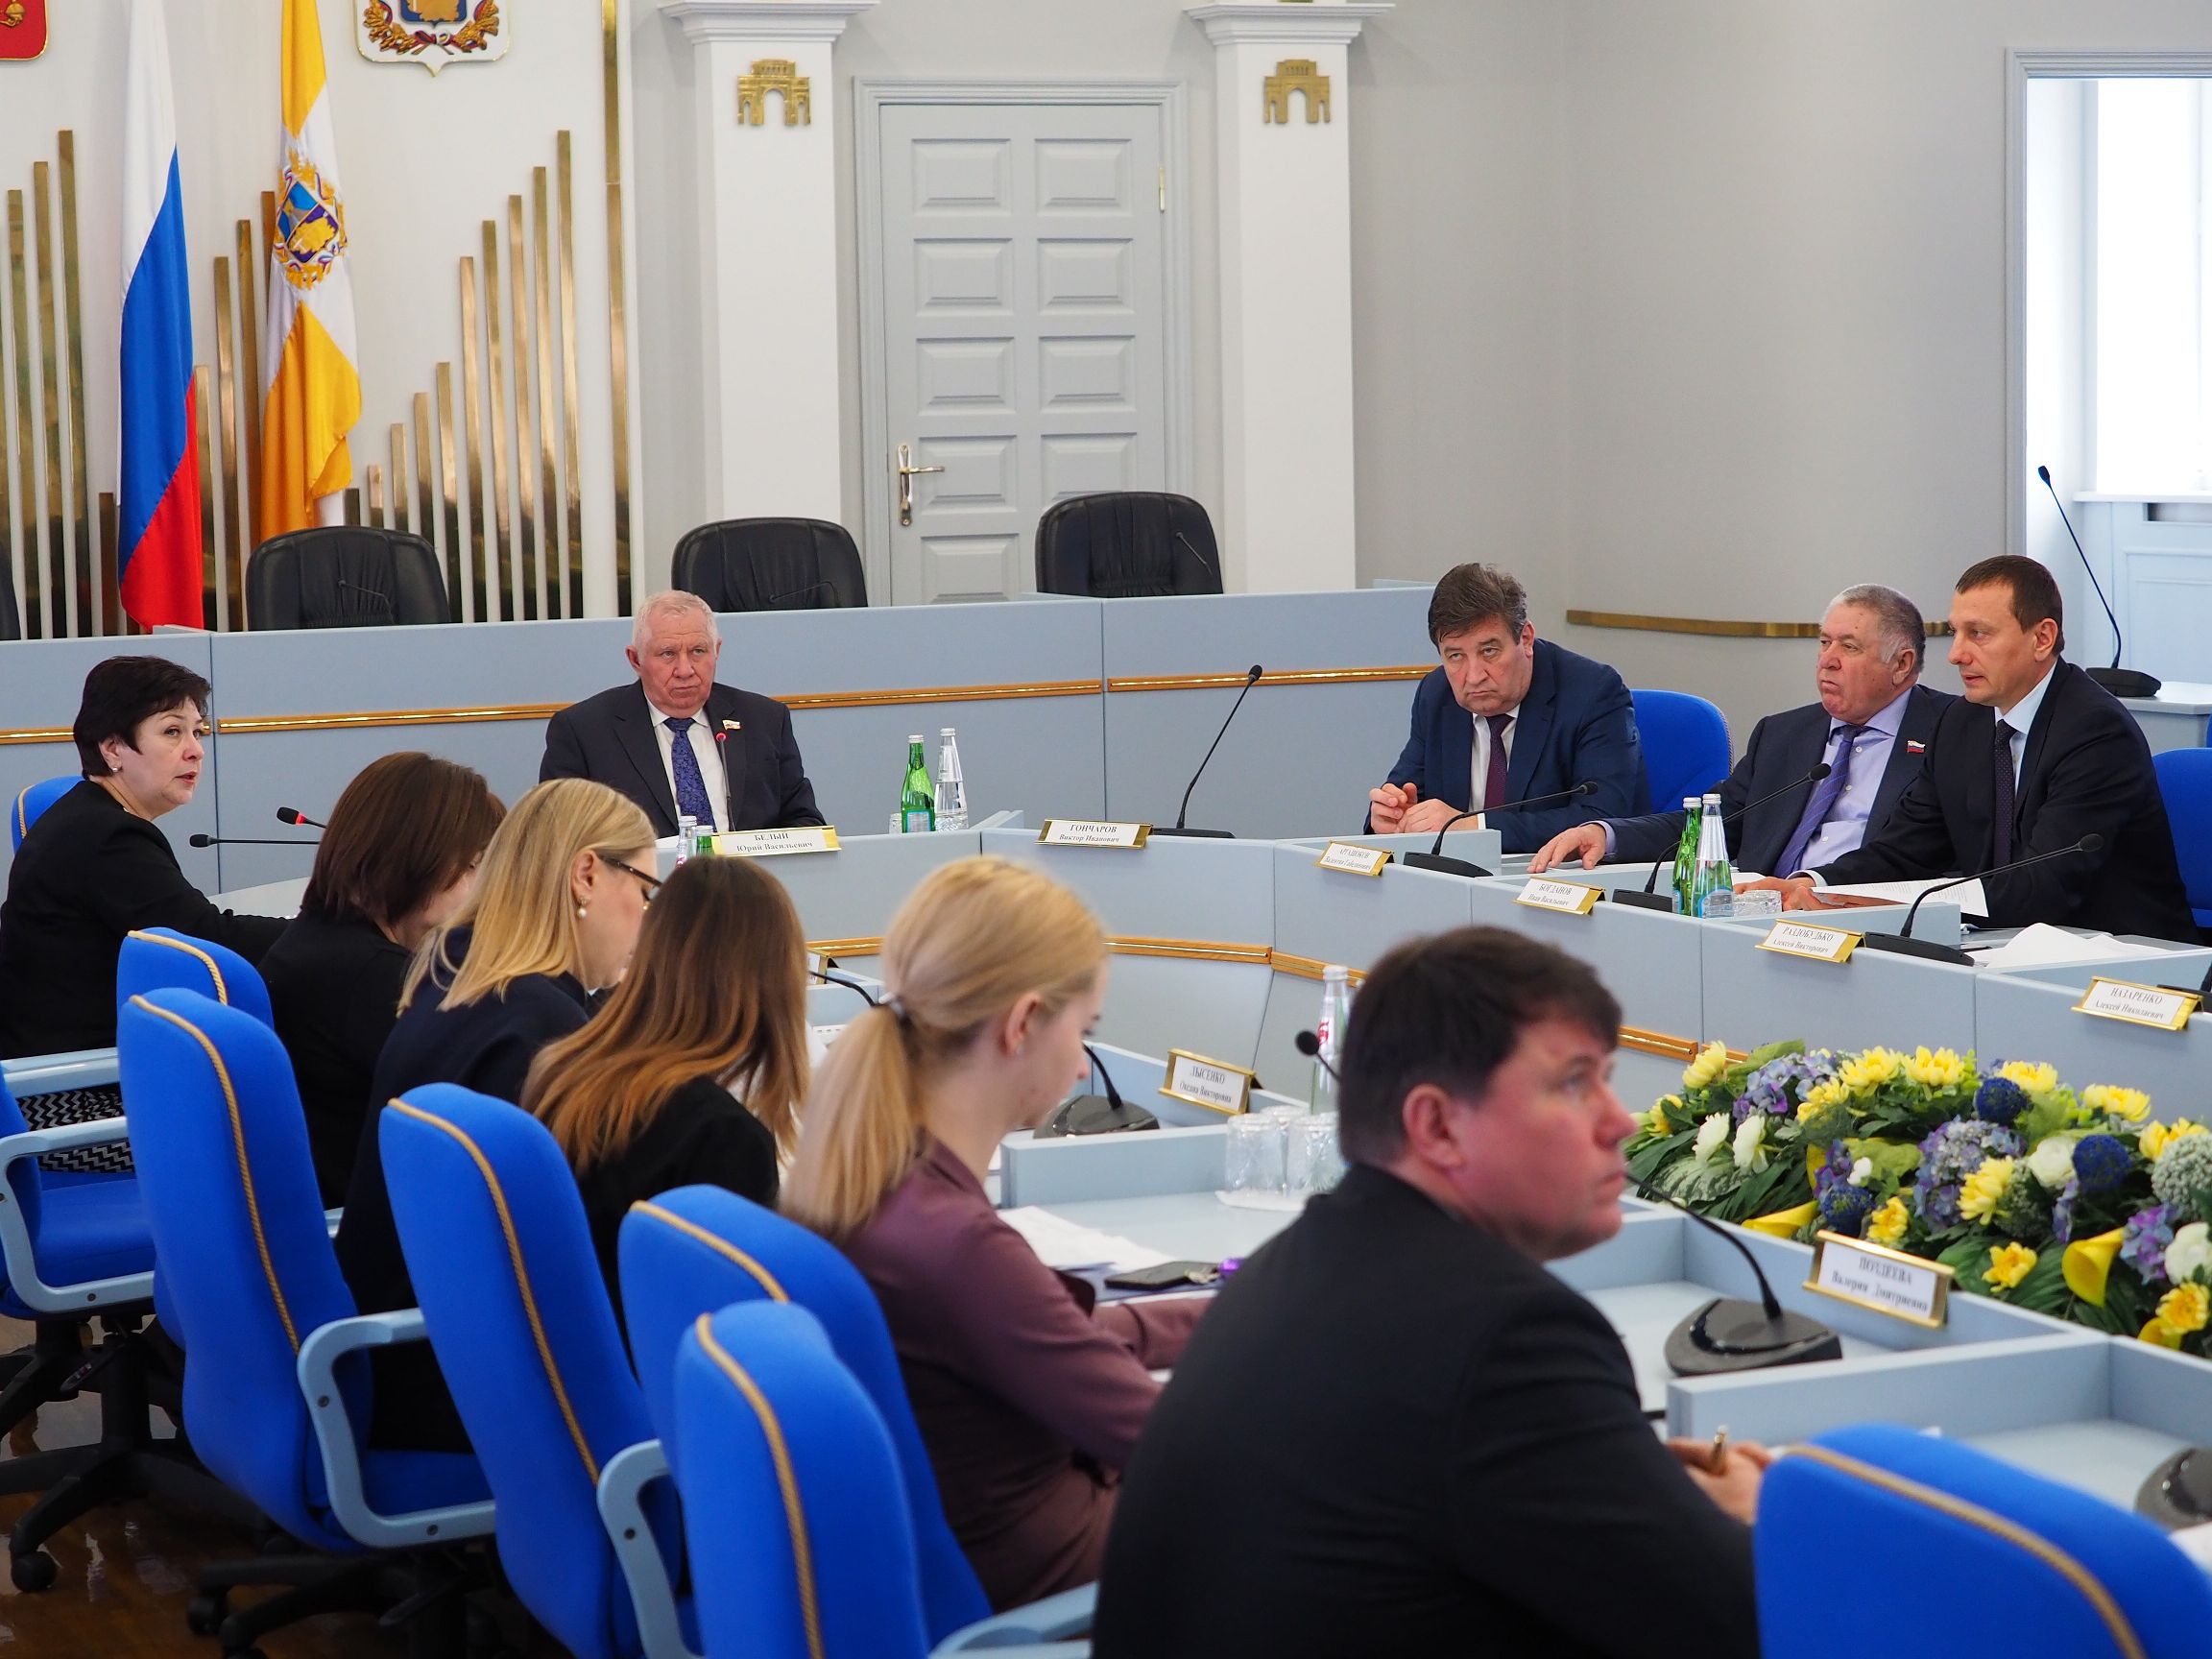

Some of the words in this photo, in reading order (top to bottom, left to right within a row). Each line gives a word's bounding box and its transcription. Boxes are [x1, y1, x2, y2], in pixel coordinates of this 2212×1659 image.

[1070, 824, 1118, 833] ГОНЧАРОВ
[1059, 833, 1084, 842] Виктор
[1085, 834, 1119, 843] Иванович
[736, 843, 762, 853] Юрий
[764, 842, 813, 851] Васильевич
[1538, 883, 1573, 896] БОГДАНОВ
[1773, 937, 1795, 949] Алексей
[1794, 940, 1829, 953] Викторович
[2110, 987, 2163, 1005] НАЗАРЕНКО
[2095, 998, 2121, 1011] Алексей
[2121, 1003, 2164, 1020] Николаевич
[1190, 1066, 1226, 1085] ЛЫСЕНКО
[1179, 1080, 1199, 1094] Оксана
[1198, 1085, 1232, 1104] Викторовна
[1874, 1283, 1929, 1313] Дмитриевна
